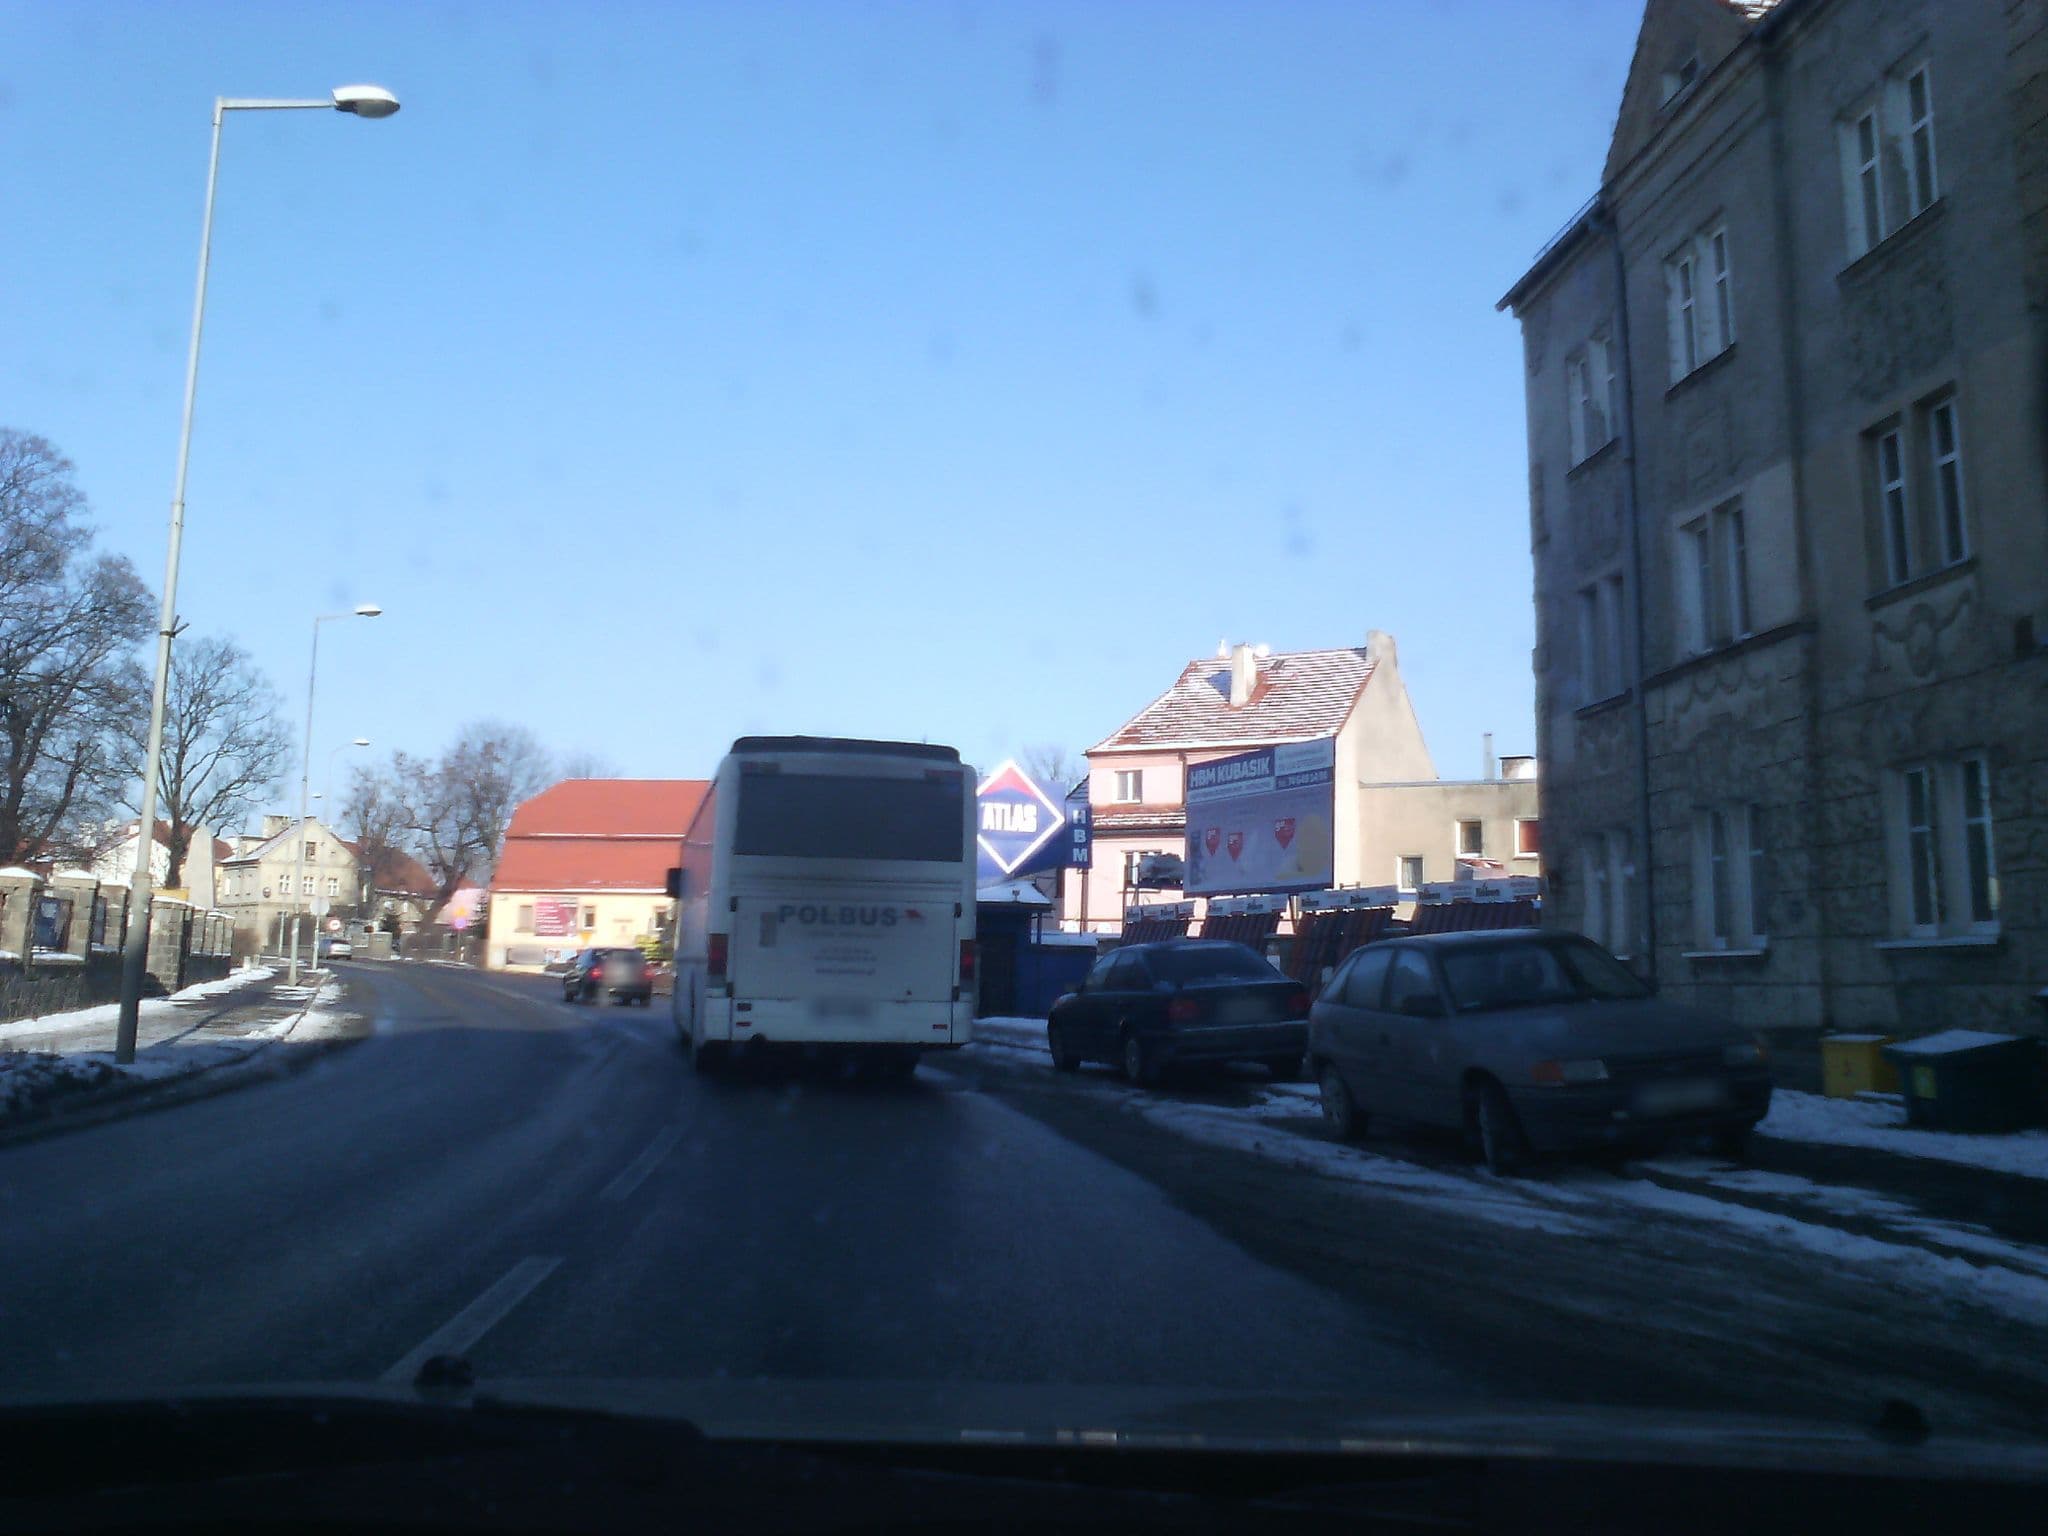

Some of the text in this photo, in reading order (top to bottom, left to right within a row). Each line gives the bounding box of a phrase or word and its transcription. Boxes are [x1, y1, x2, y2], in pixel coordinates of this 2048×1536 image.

[1190, 767, 1217, 788] HBM
[981, 801, 1038, 833] ATLAS
[1071, 808, 1089, 863] HBM
[777, 904, 898, 927] POLBUS
